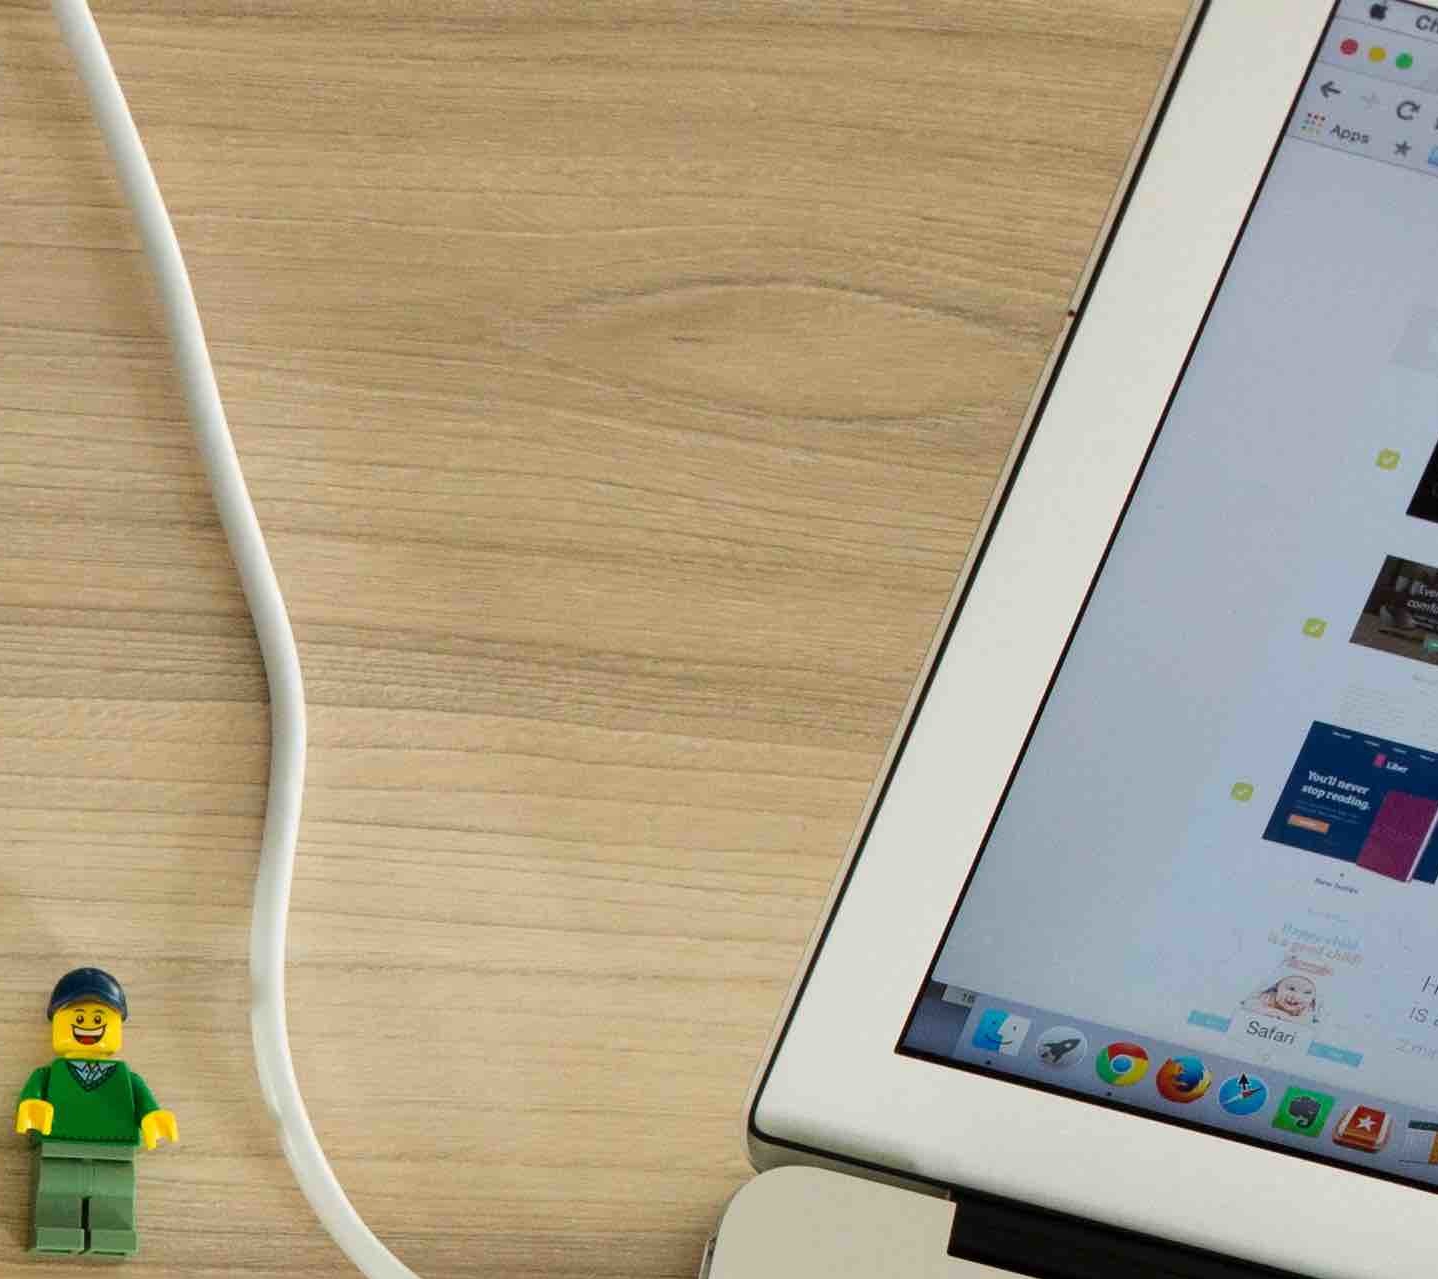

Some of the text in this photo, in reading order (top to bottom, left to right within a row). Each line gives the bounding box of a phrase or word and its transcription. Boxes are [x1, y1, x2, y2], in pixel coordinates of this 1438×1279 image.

[1330, 124, 1370, 144] Apps
[1308, 770, 1370, 794] You'll never
[1301, 785, 1372, 811] stop reading.
[1246, 1020, 1297, 1045] Safari
